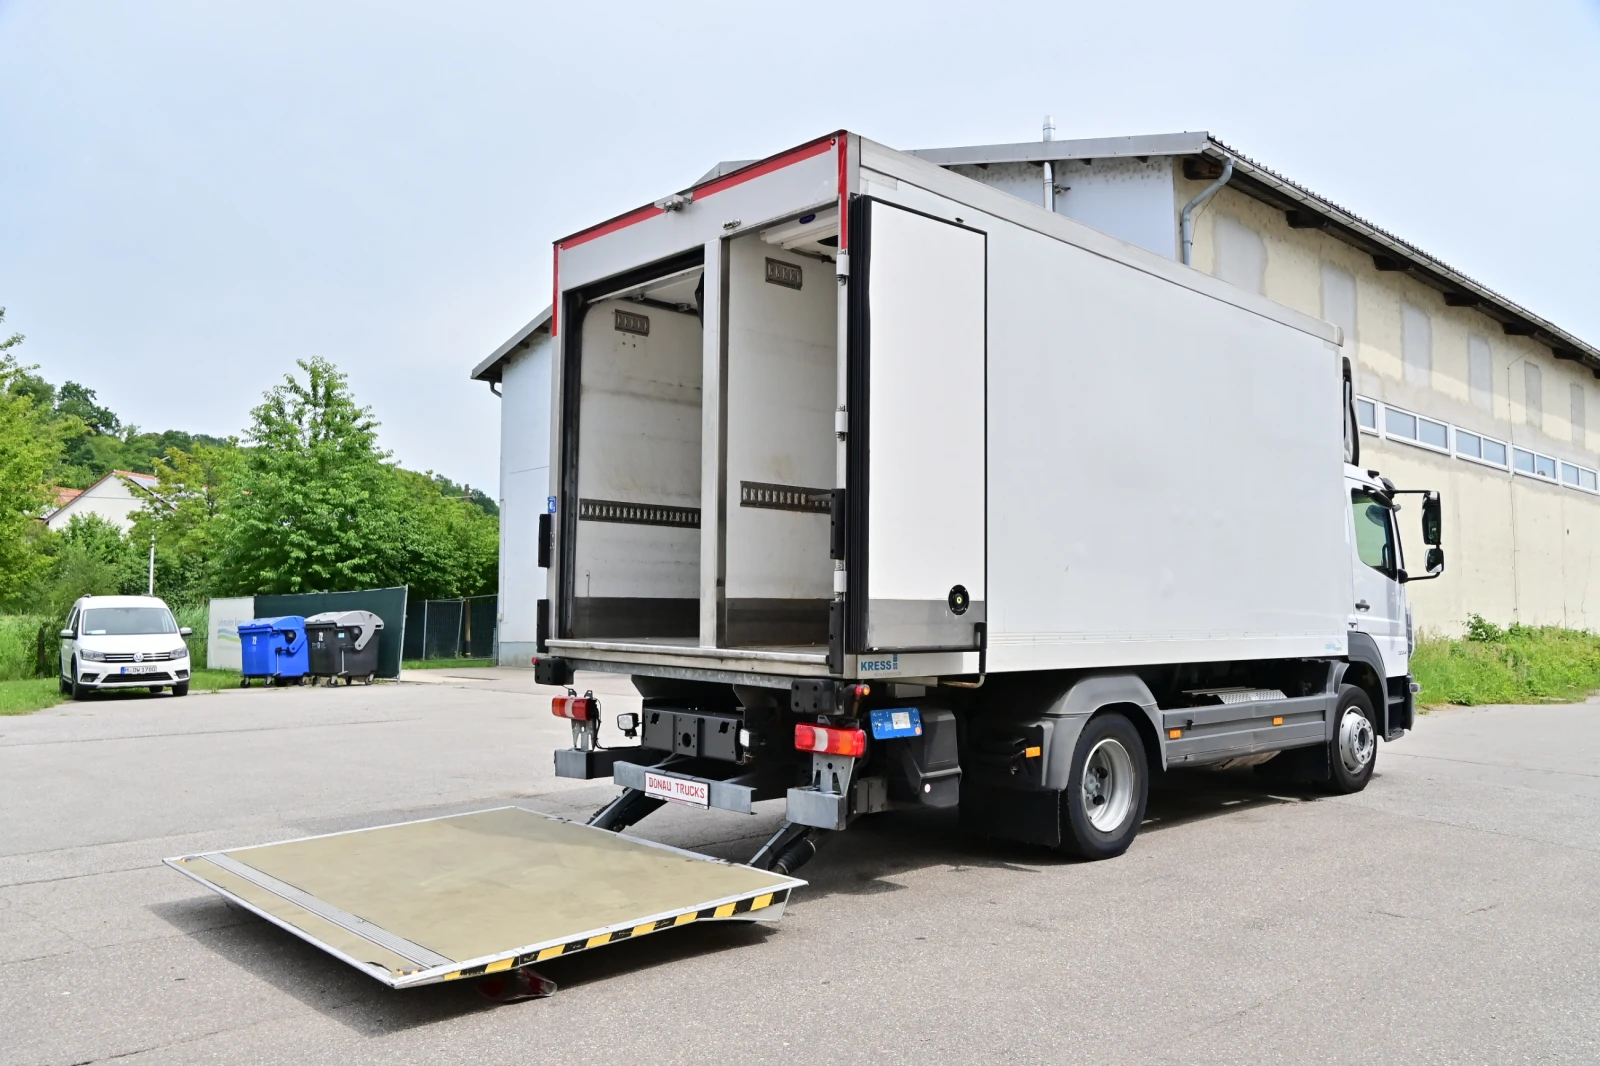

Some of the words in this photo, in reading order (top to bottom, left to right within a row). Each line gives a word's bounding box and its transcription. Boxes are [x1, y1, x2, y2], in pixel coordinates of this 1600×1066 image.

[860, 660, 892, 671] KRESS
[648, 777, 672, 792] DONAU
[675, 782, 705, 799] TRUCKS
